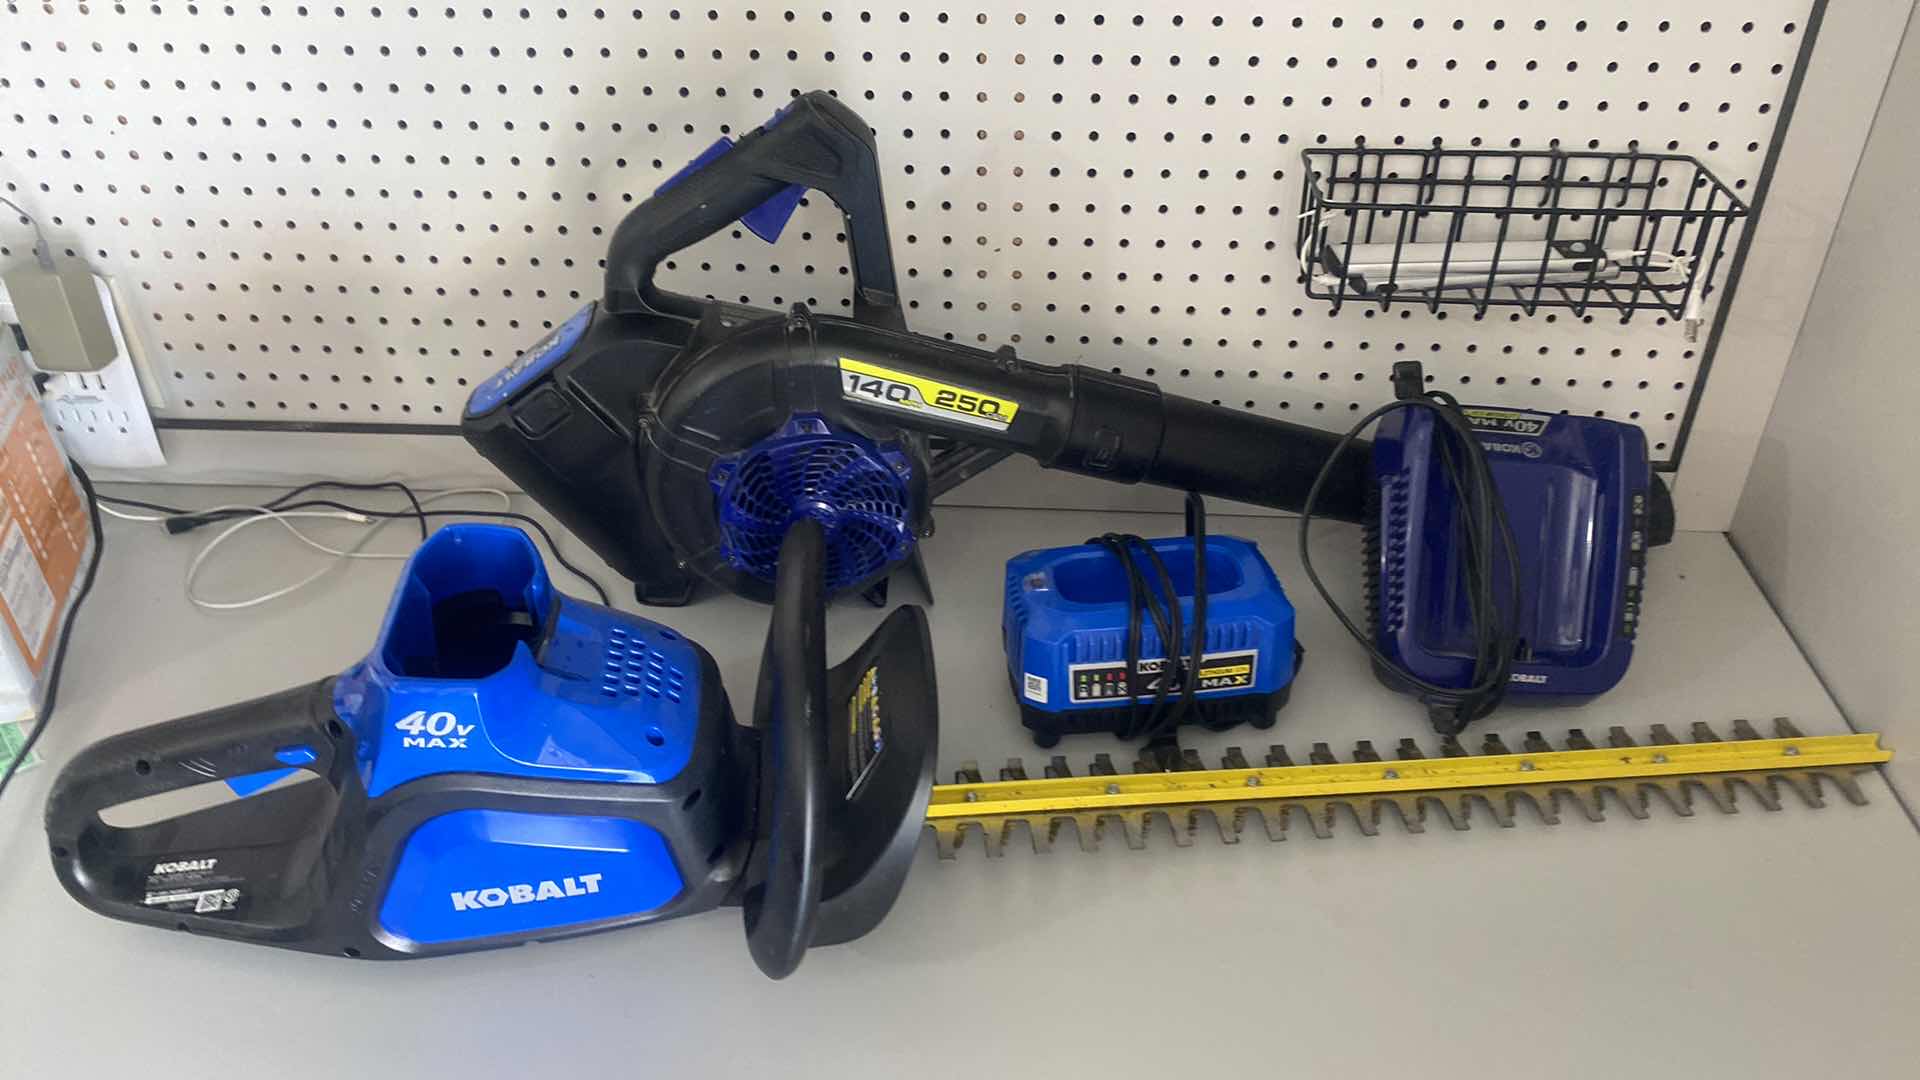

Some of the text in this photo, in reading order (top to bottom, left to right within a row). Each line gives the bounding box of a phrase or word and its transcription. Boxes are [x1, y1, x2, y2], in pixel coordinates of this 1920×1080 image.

[849, 374, 911, 403] 140
[935, 389, 1001, 416] 250
[1467, 416, 1499, 427] MA
[1202, 676, 1248, 688] MAX
[1509, 673, 1548, 684] OBALT
[403, 737, 468, 748] MAX
[153, 858, 218, 874] KOBALT
[451, 873, 603, 911] KOBALT
